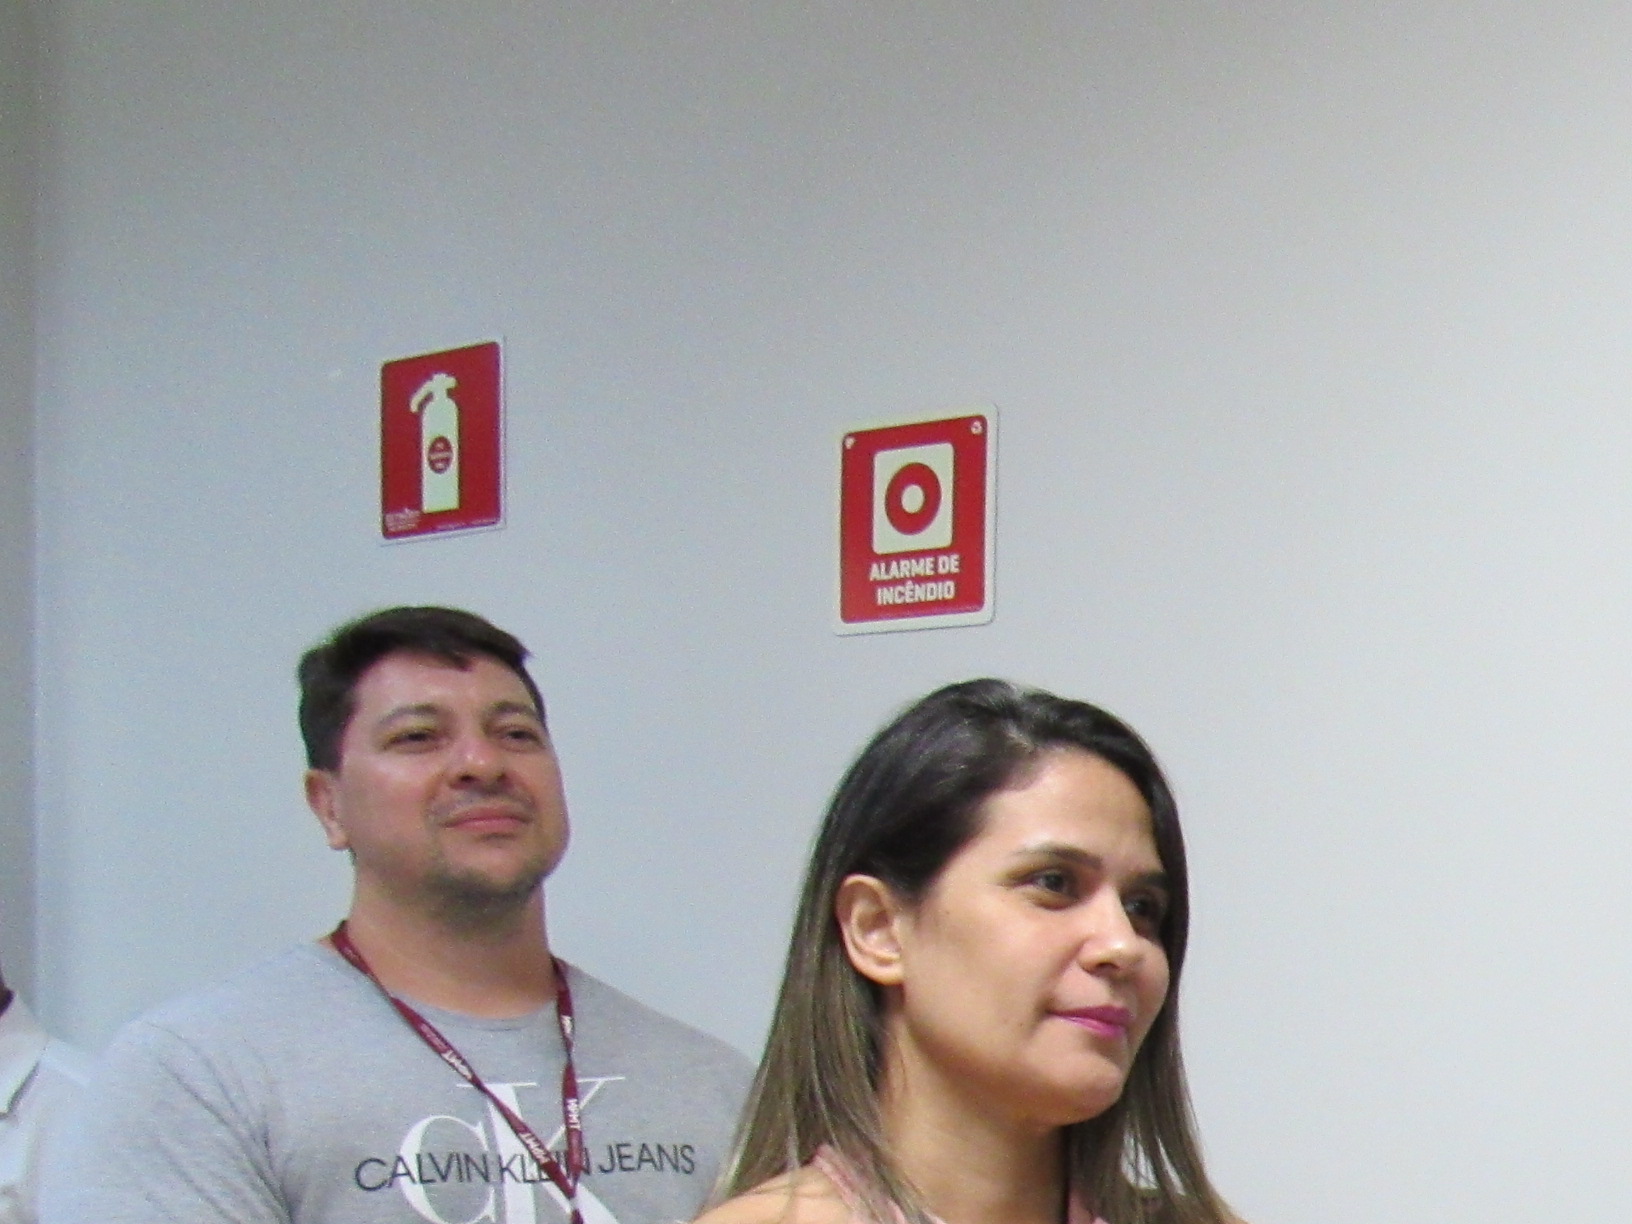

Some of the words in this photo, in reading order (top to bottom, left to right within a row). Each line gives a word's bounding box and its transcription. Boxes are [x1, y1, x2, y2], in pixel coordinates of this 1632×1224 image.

[869, 556, 935, 581] ALARME
[937, 553, 960, 574] DE
[876, 580, 956, 606] INCÊNDIO
[354, 1152, 492, 1192] CALVIN
[599, 1143, 696, 1175] JEANS
